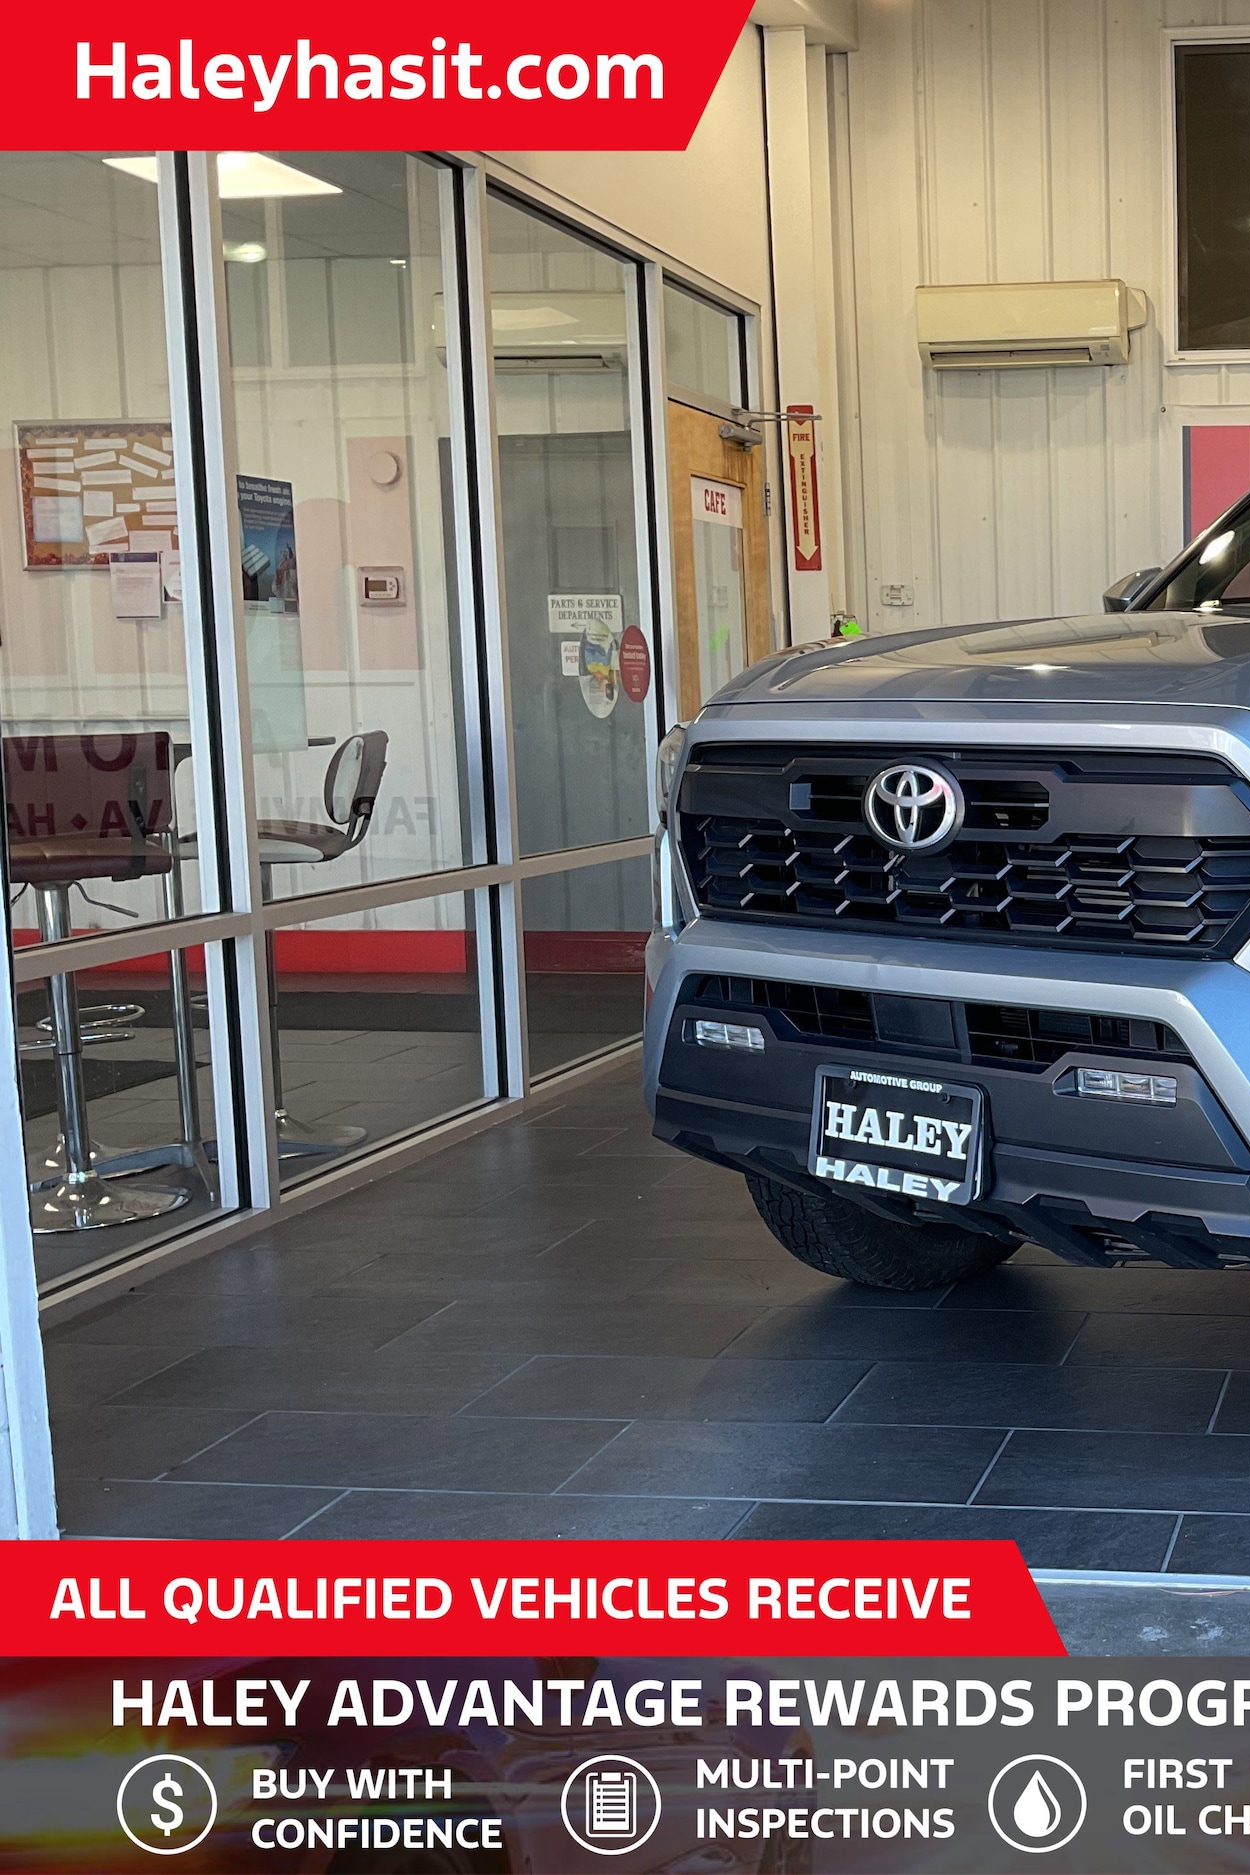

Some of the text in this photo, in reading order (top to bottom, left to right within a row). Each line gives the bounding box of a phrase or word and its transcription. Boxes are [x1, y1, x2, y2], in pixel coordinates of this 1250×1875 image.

[792, 433, 811, 442] FIRE
[704, 488, 726, 515] CAFE
[799, 453, 810, 535] EXTINGUISHER
[551, 599, 576, 609] PARTS
[585, 599, 619, 609] SERVICE
[558, 610, 613, 620] DEPARTMENTS
[850, 1070, 943, 1094] AUTOMOTIVE GROUP
[825, 1101, 972, 1160] HALEY
[815, 1157, 961, 1202] HALEY
